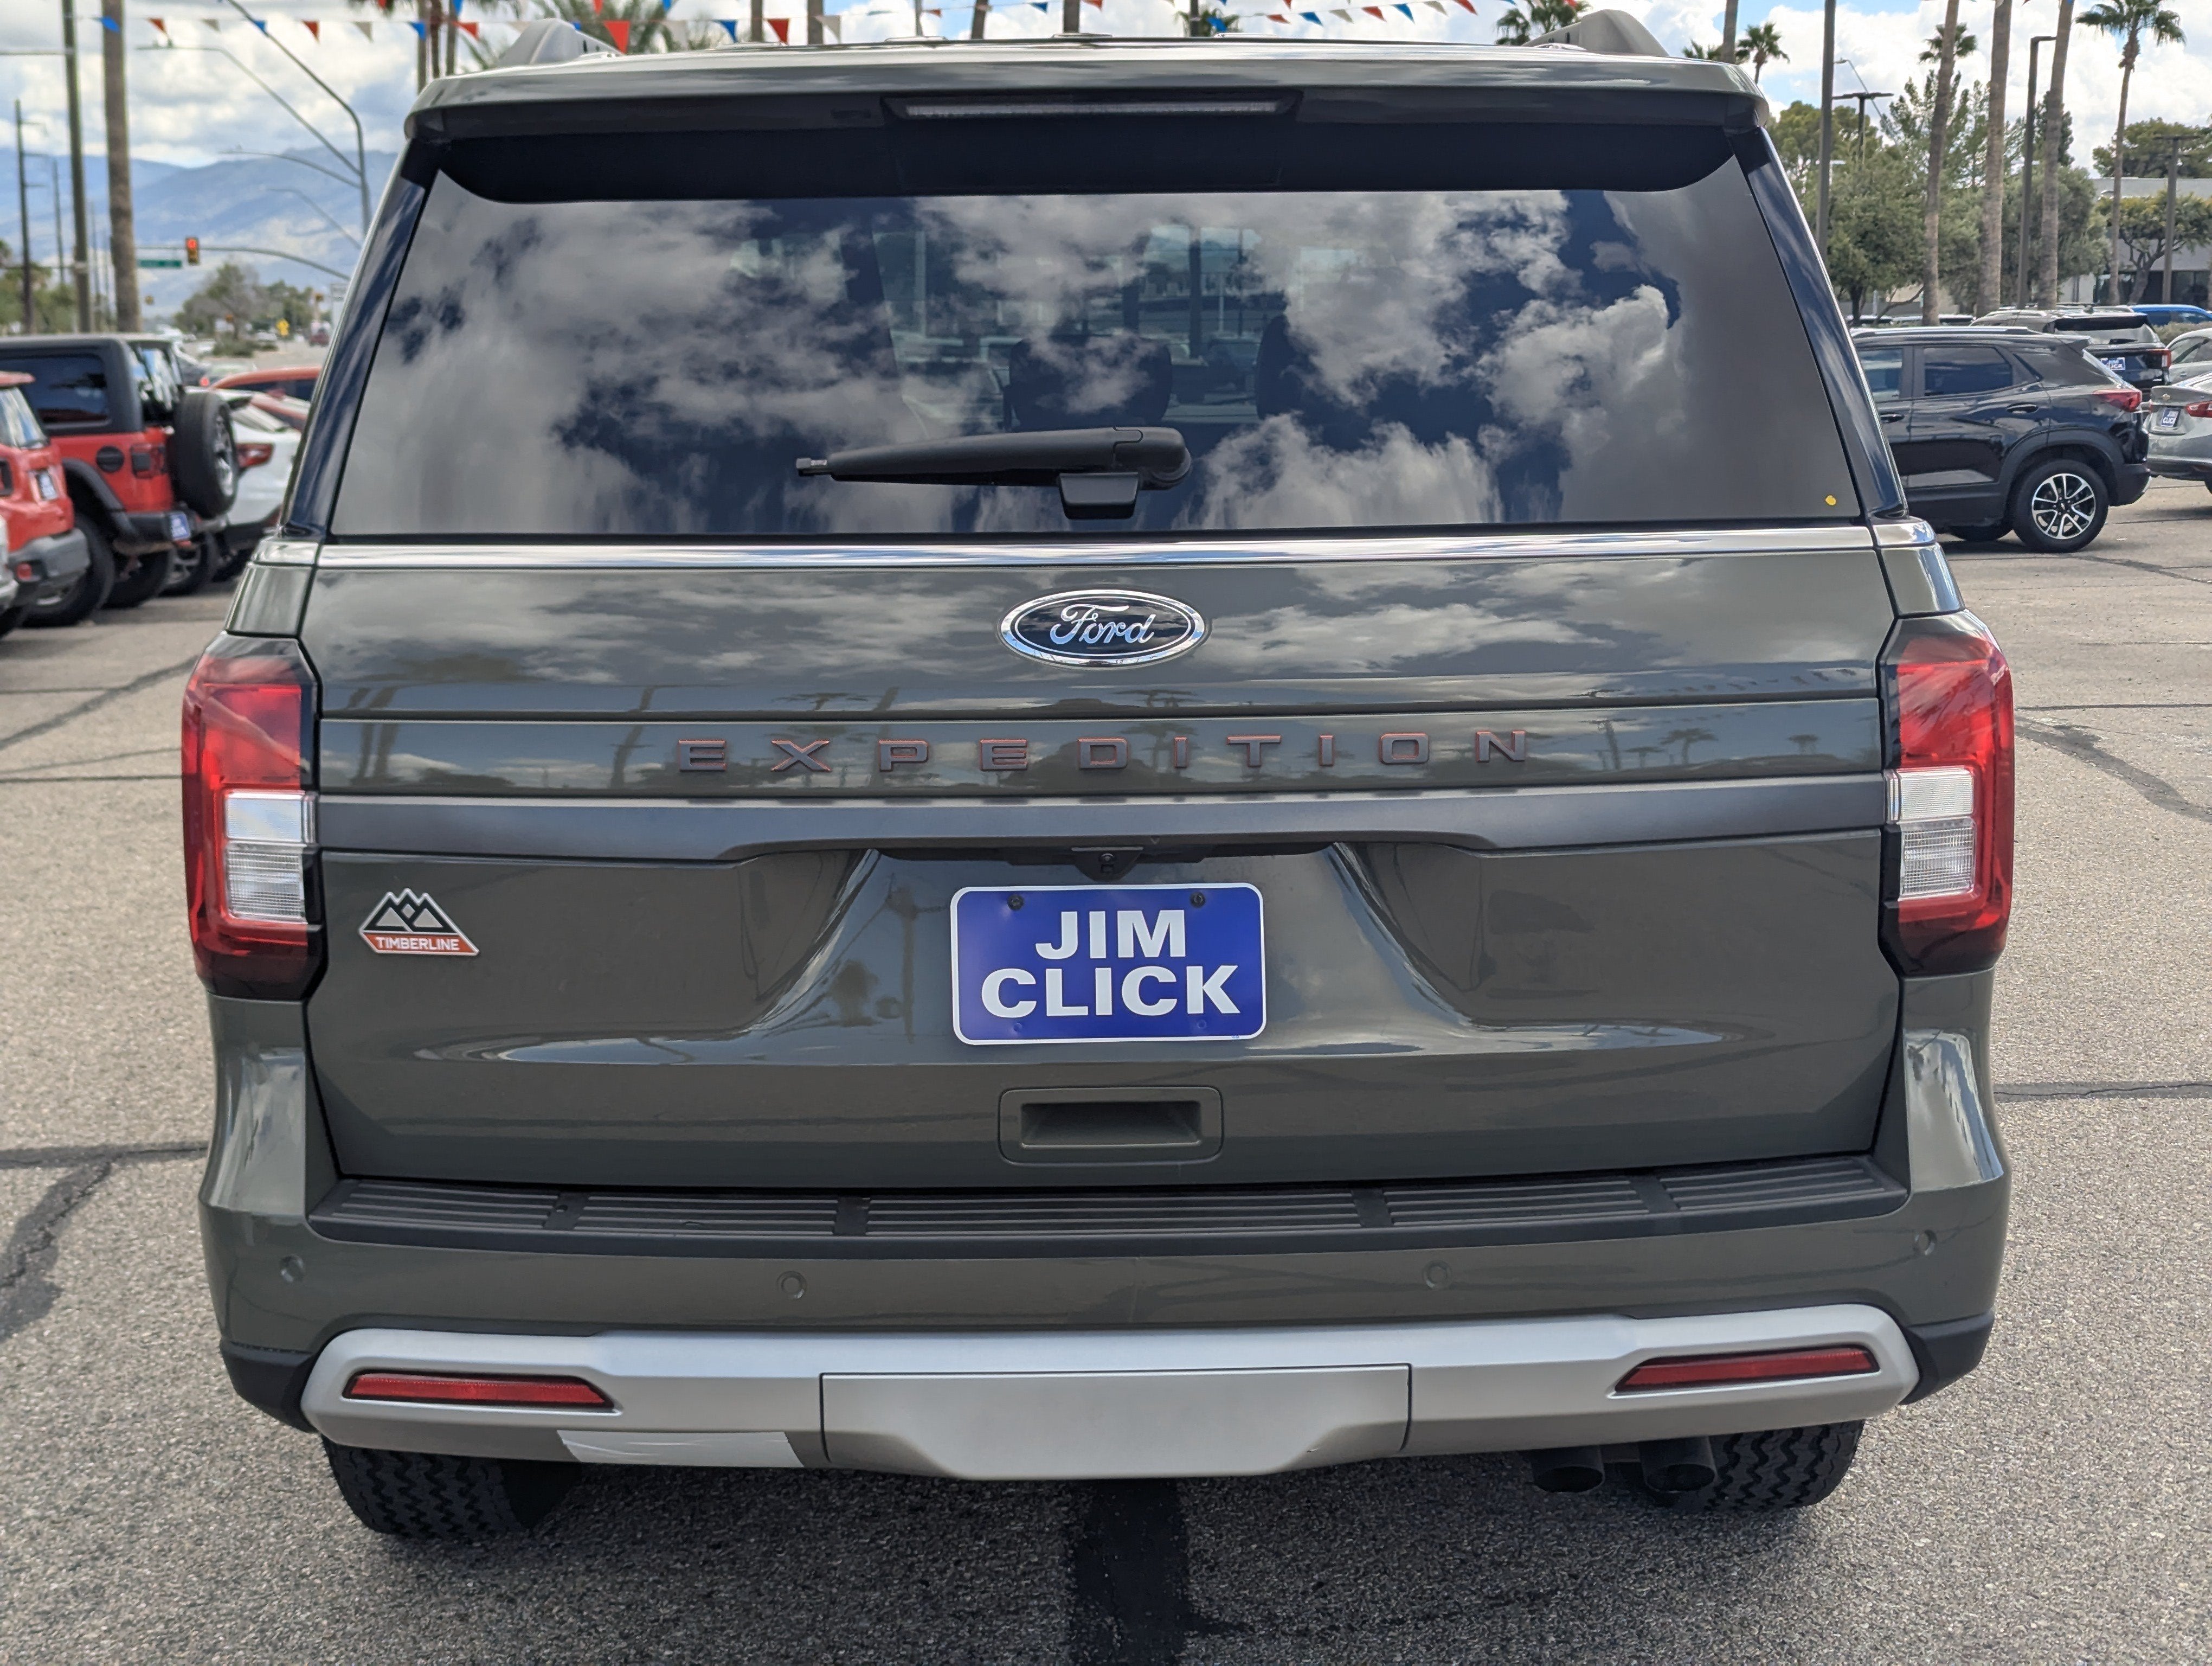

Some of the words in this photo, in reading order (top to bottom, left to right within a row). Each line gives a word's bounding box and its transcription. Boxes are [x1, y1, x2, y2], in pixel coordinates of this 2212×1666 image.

[1050, 604, 1156, 644] Ford
[678, 730, 1527, 772] EXPEDITION
[375, 937, 460, 951] TIMBERLINE
[1035, 909, 1186, 959] JIM
[981, 965, 1240, 1018] CLICK
